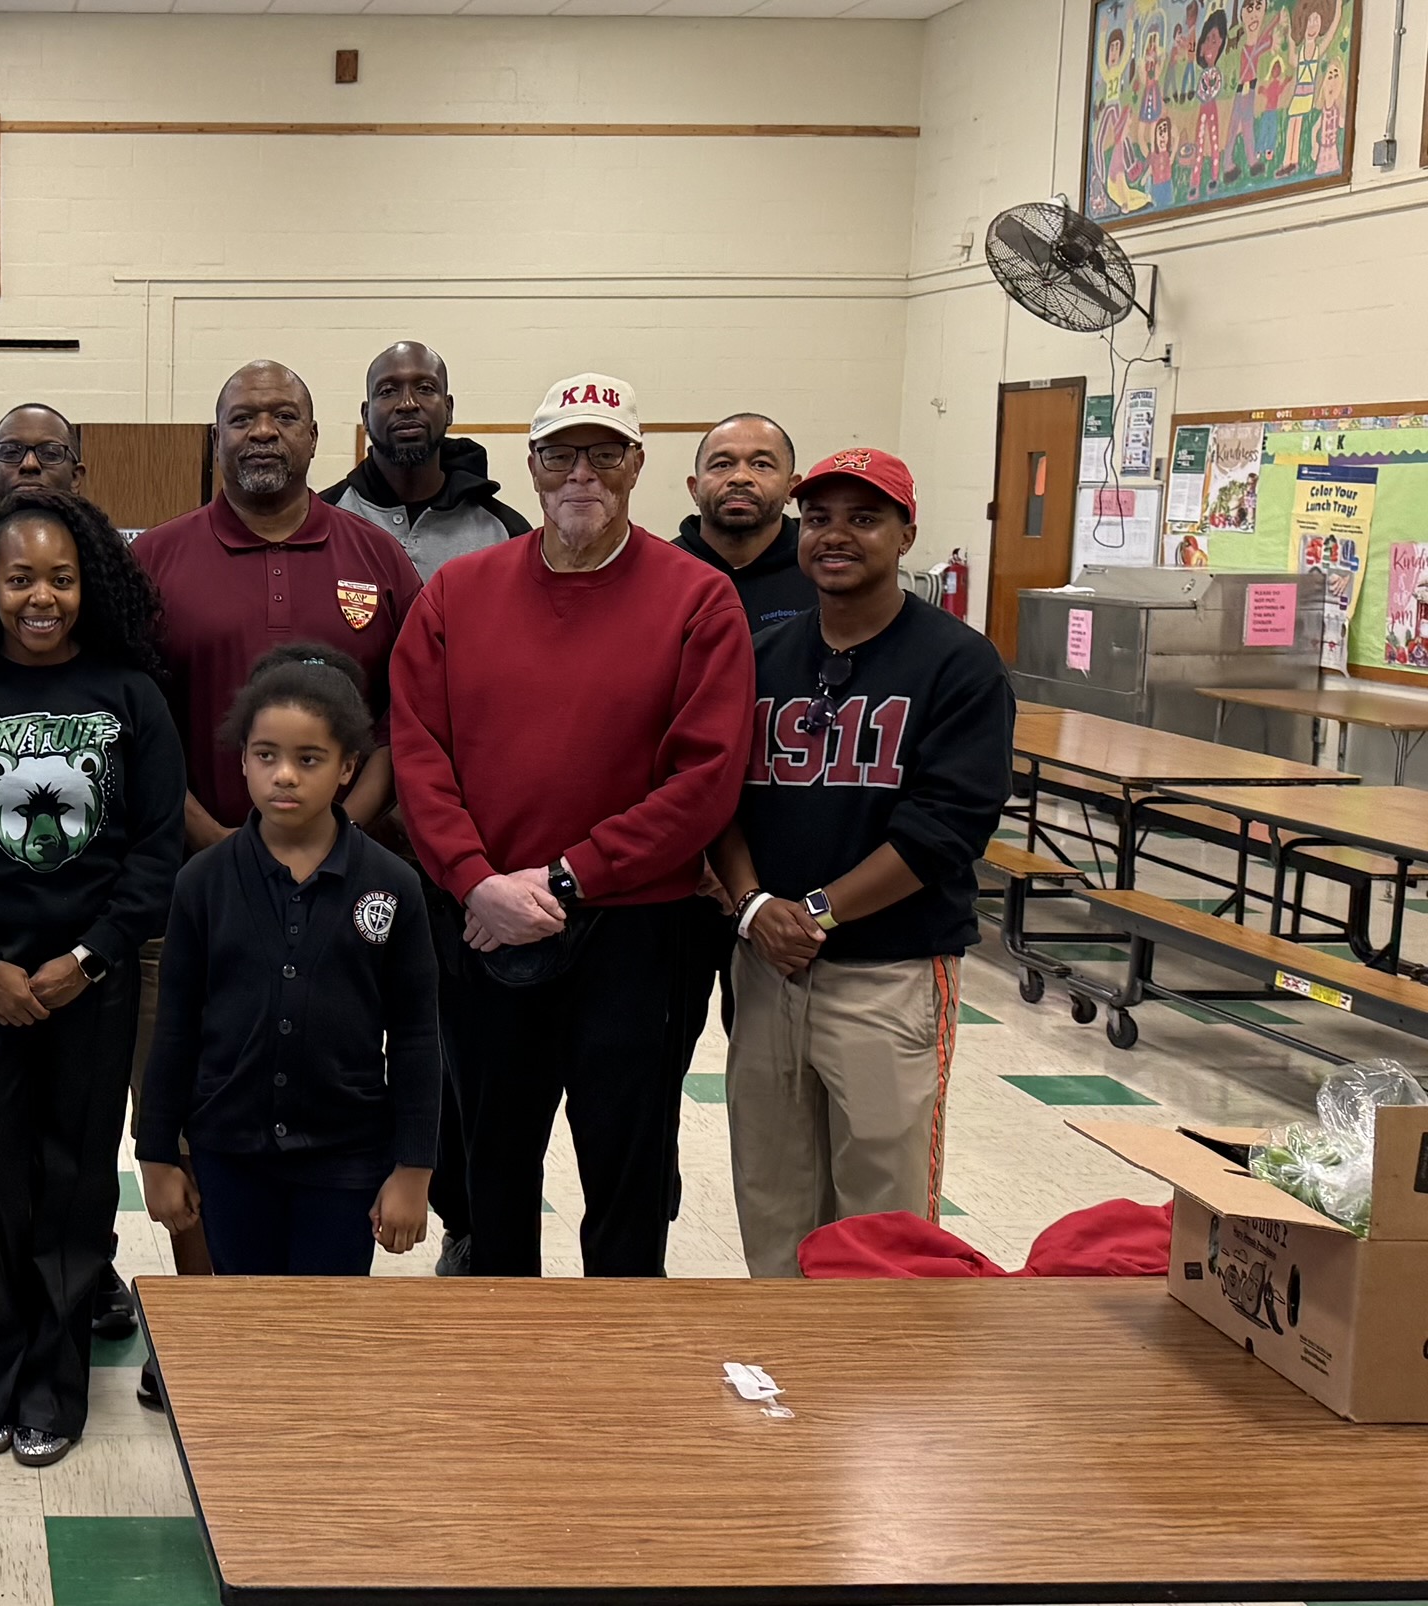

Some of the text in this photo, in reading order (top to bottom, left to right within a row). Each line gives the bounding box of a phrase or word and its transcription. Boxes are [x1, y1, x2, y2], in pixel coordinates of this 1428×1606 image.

[1310, 484, 1358, 500] Color Your
[1305, 499, 1358, 518] Lunch Tray!
[744, 695, 911, 789] 1911
[357, 892, 385, 909] CLINTON
[354, 910, 377, 942] CHRISTIAN
